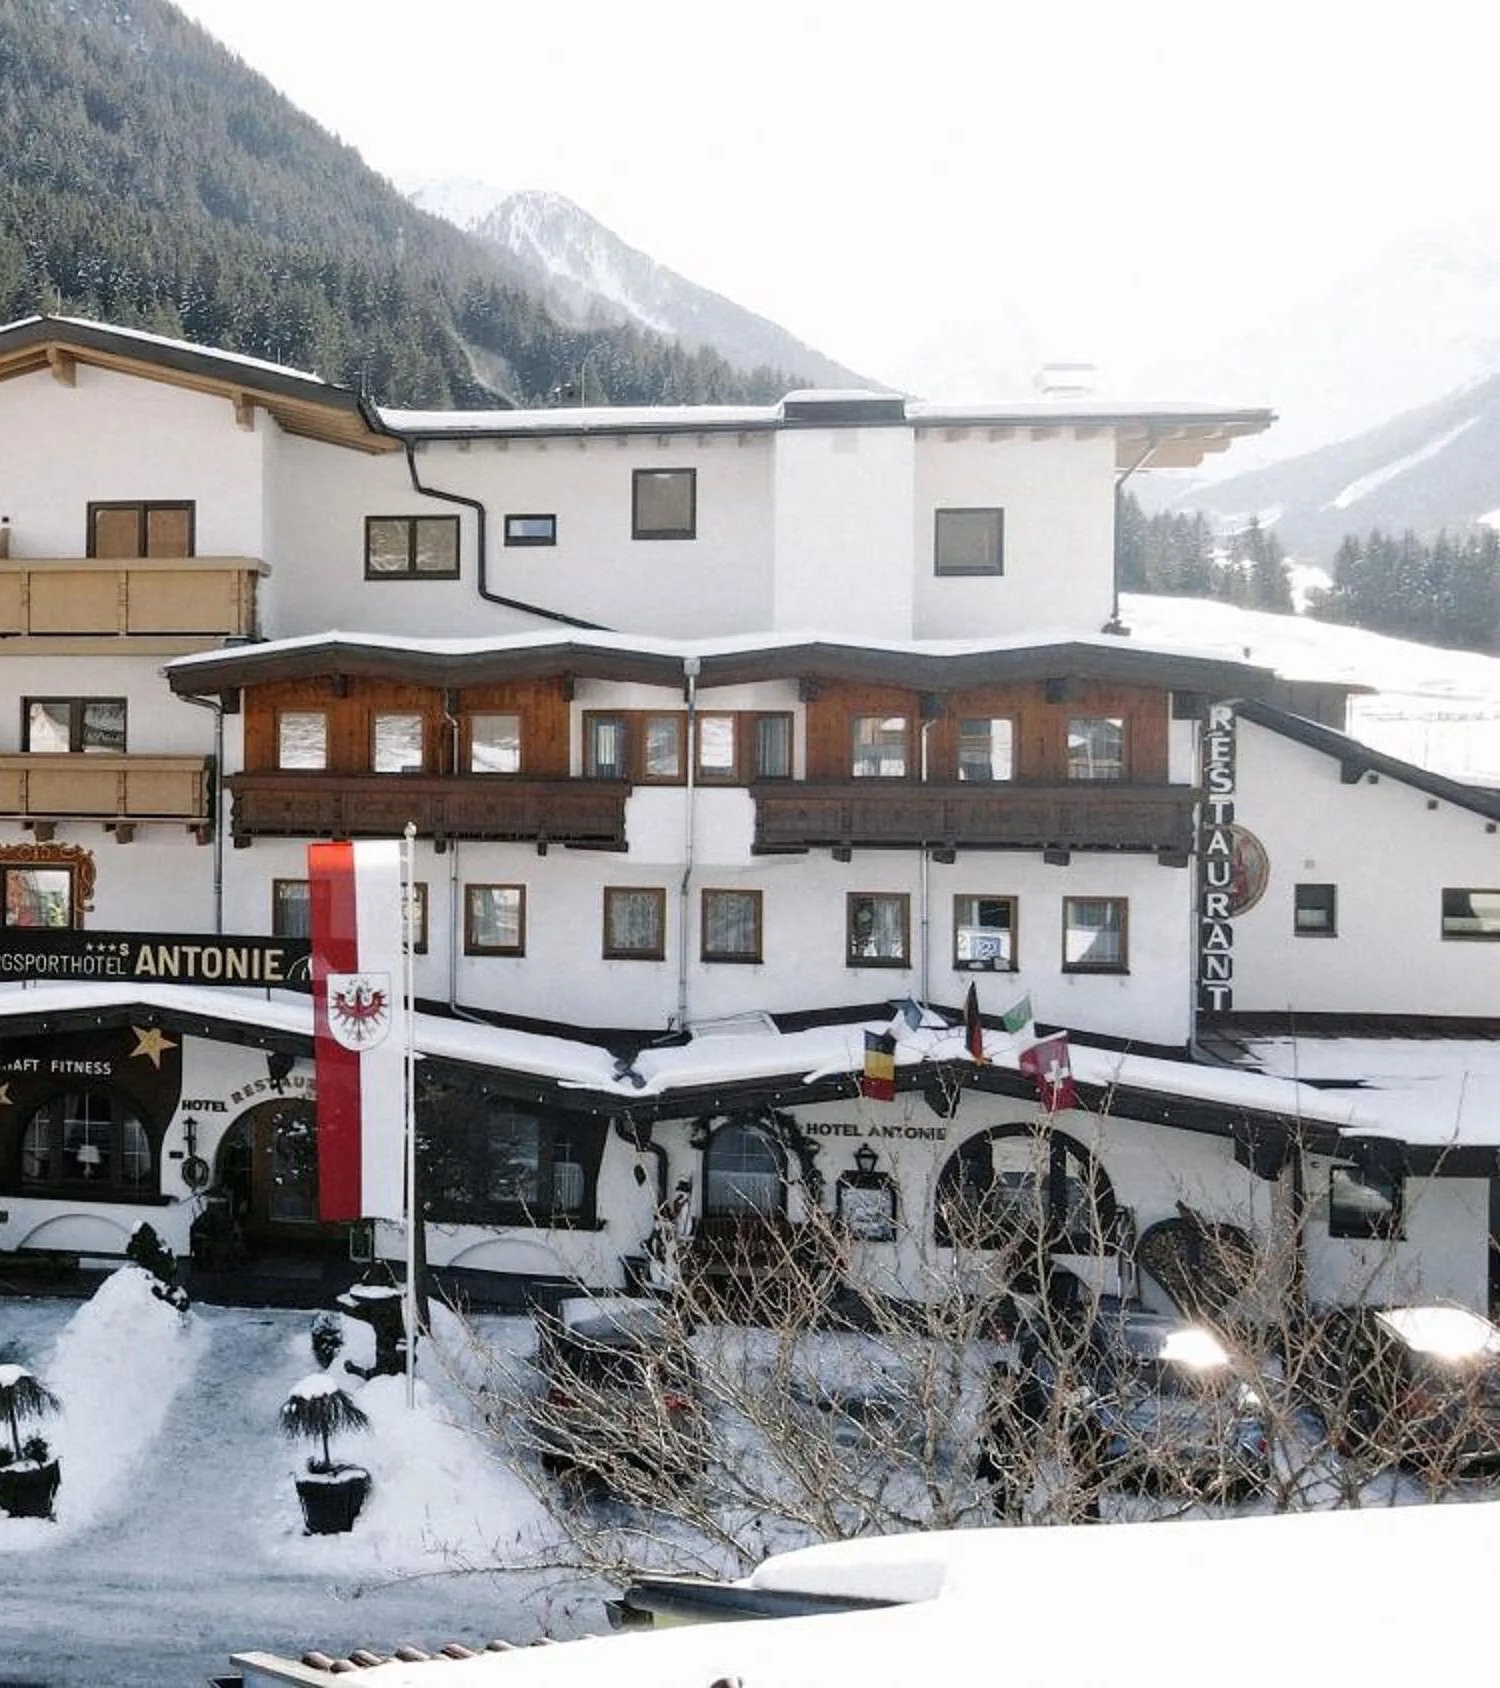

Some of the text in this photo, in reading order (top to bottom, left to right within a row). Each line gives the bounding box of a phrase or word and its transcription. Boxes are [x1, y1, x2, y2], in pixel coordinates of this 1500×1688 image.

[1206, 706, 1233, 1010] RESTAURANT
[134, 944, 286, 981] ANTONIE
[51, 1059, 113, 1076] FITNESS
[181, 1100, 228, 1113] HOTEL
[806, 1123, 947, 1141] HOTEL ANTONIE
